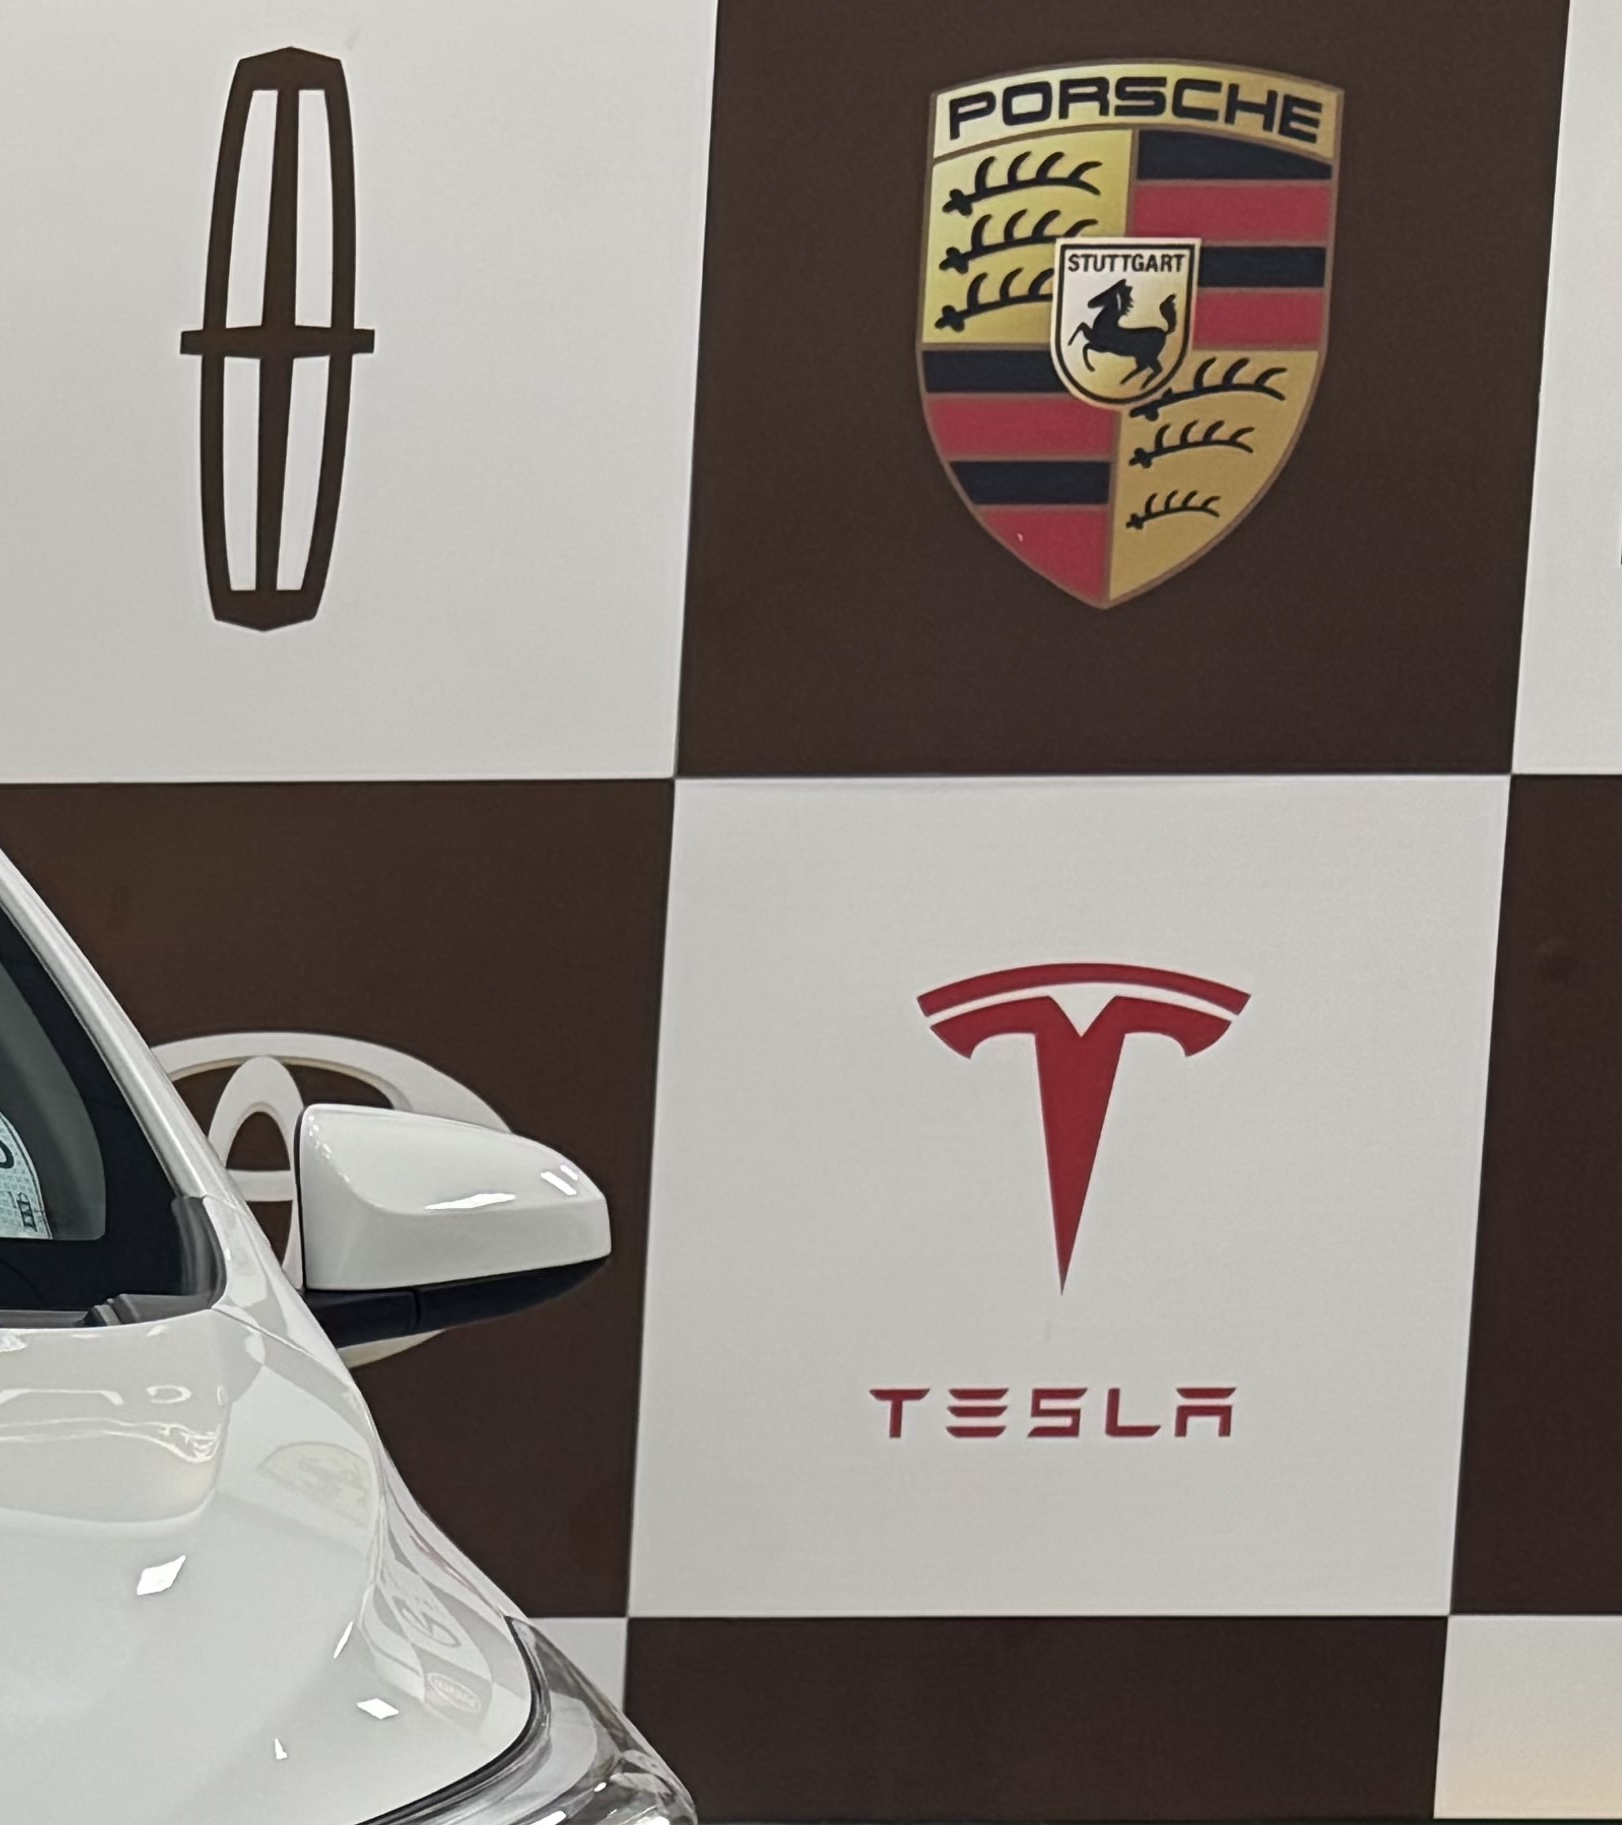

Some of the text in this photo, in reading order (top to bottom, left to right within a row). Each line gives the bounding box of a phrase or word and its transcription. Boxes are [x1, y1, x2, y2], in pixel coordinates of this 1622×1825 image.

[947, 75, 1324, 145] PORSCHE
[1067, 253, 1186, 274] STUTTGART
[868, 1386, 1237, 1438] TESLA
